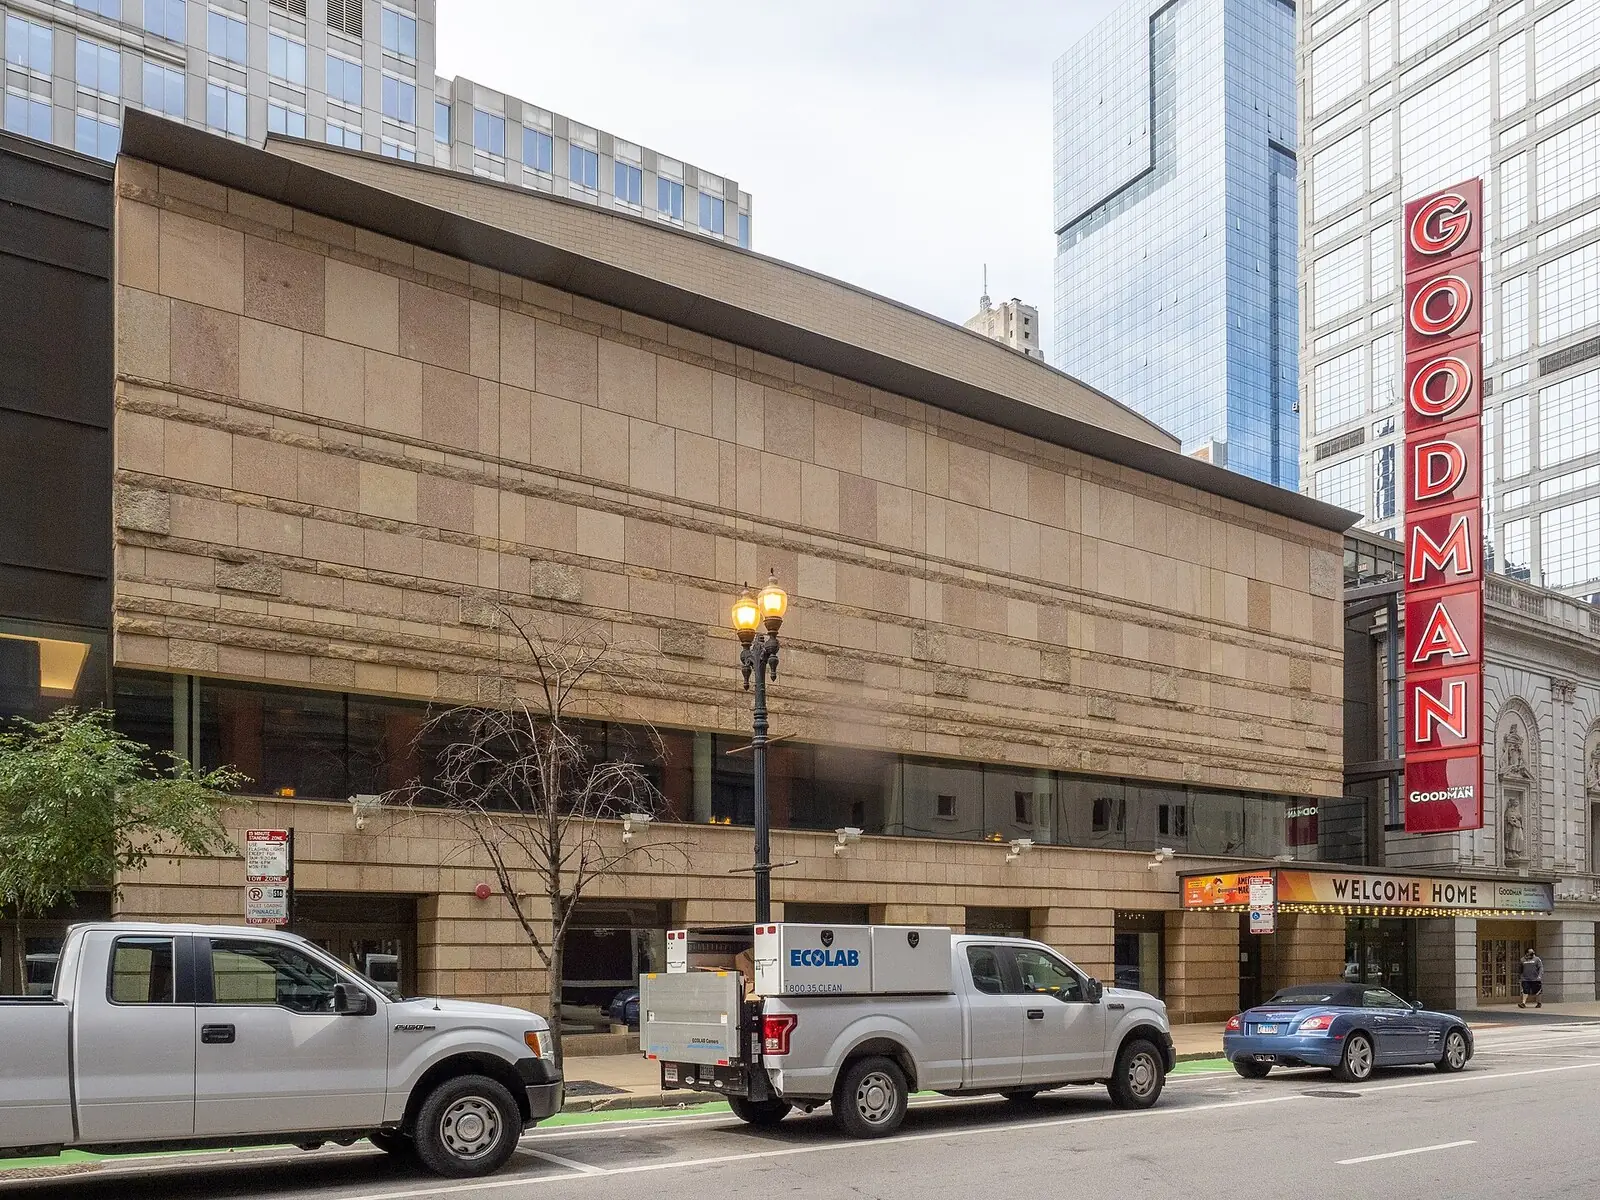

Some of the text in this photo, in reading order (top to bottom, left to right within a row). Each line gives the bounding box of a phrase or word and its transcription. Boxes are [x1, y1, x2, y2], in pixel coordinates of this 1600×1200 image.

[1409, 193, 1472, 743] GOODMAN
[1410, 790, 1473, 803] GOODMAN
[1332, 878, 1477, 904] WELCOME HOME
[791, 949, 859, 967] ECOLAB
